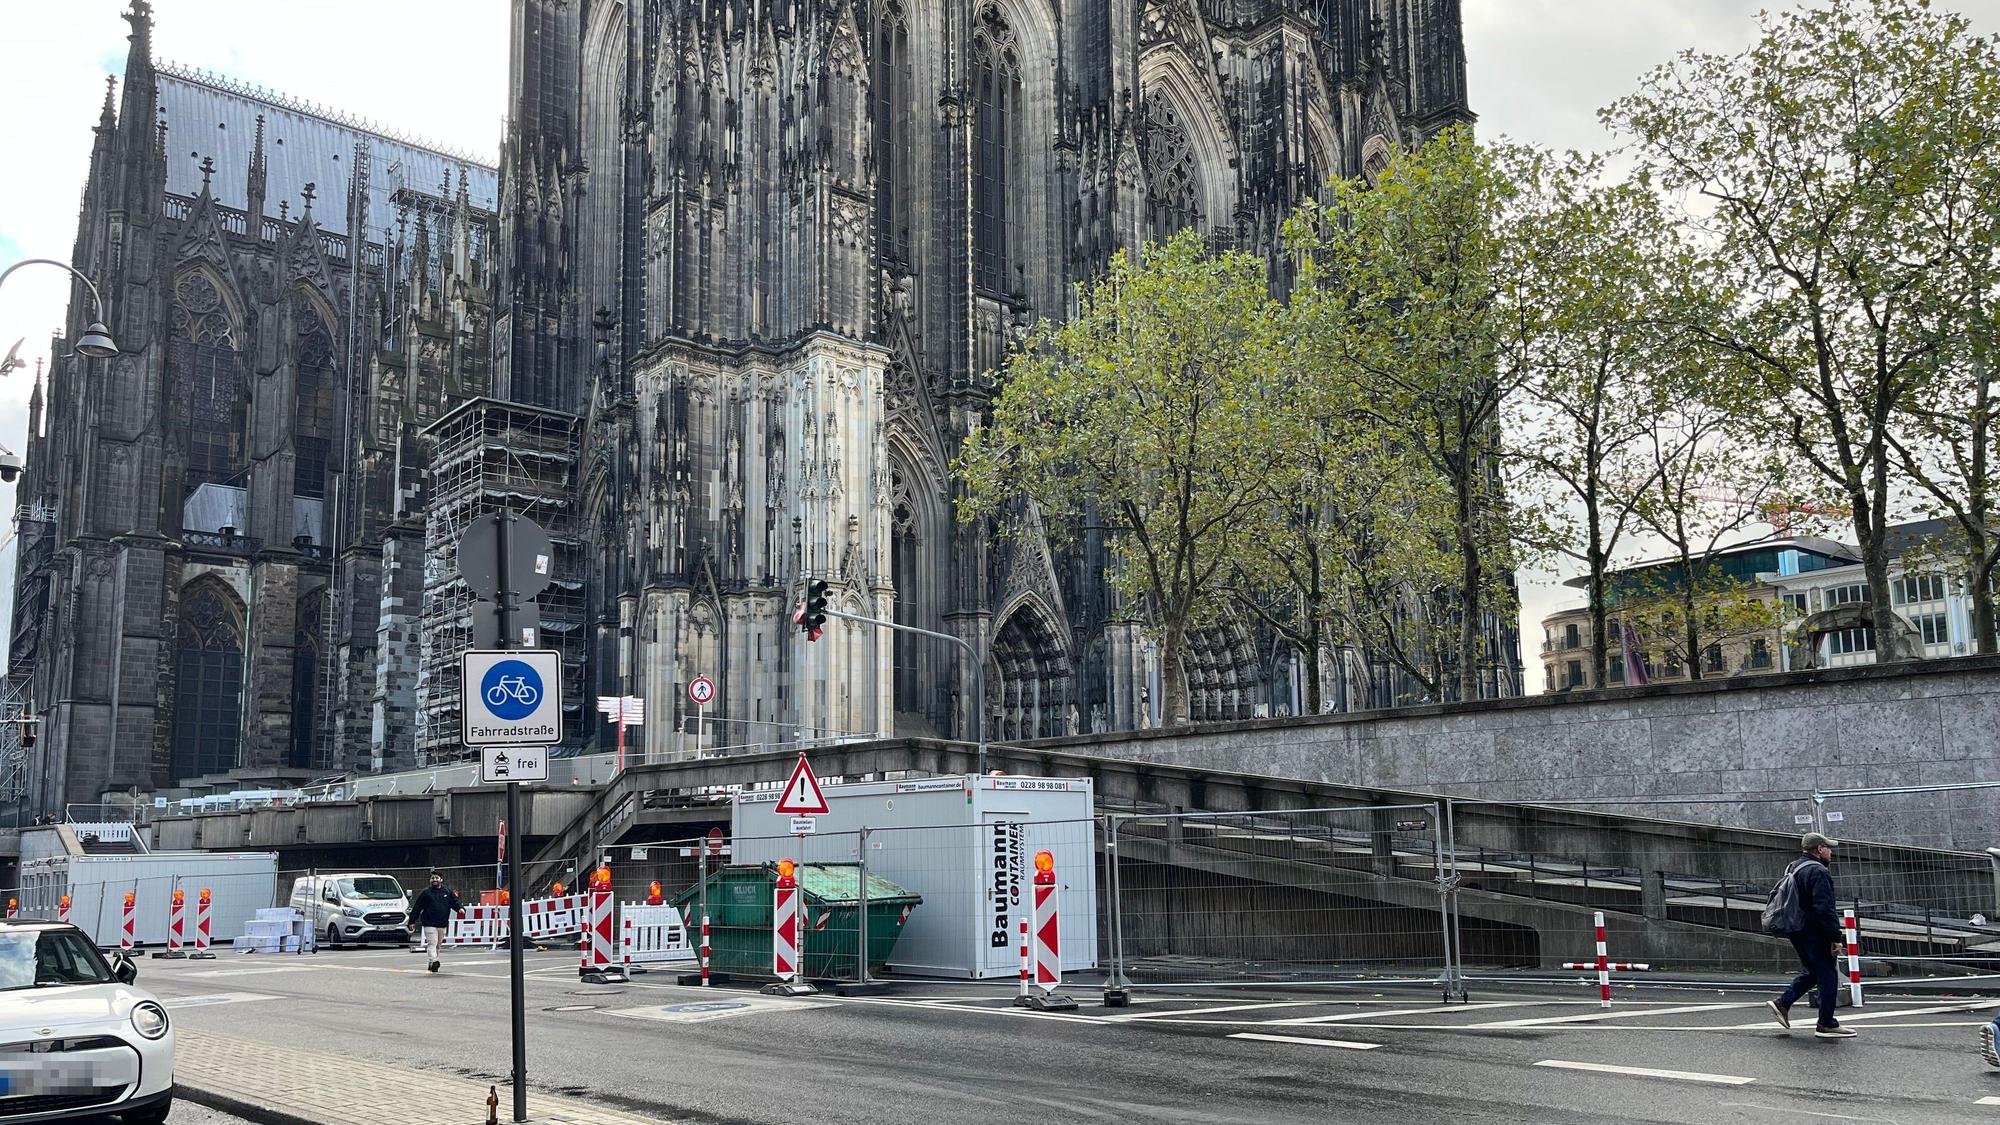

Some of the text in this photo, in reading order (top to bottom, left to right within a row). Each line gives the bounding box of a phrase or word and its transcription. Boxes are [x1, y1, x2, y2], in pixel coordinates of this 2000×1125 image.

[471, 725, 554, 737] Fahrradstraße
[517, 758, 537, 768] frei
[1020, 781, 1036, 789] 0228
[1037, 781, 1045, 789] 98
[1054, 782, 1066, 790] 081
[1009, 820, 1020, 906] CONTAINER
[991, 820, 1009, 948] Baumann
